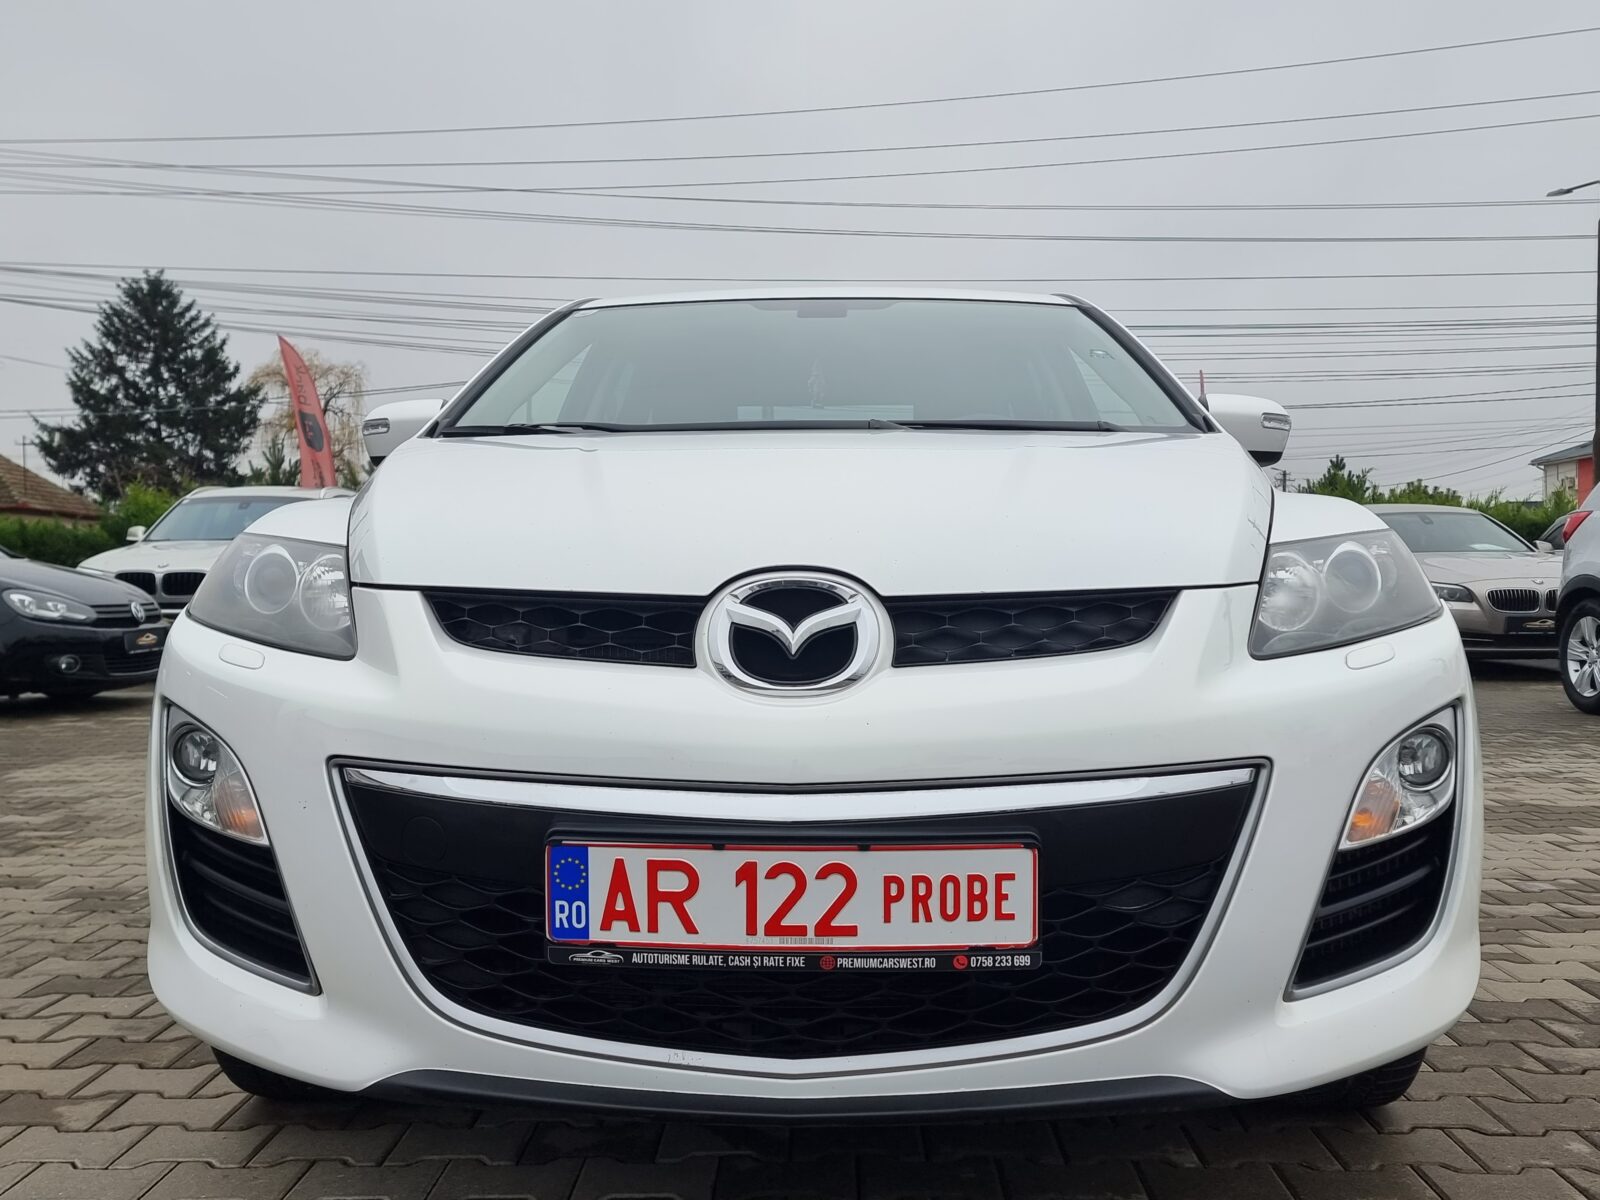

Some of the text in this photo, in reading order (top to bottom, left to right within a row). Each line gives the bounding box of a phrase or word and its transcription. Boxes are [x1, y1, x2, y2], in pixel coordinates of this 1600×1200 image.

[600, 858, 1016, 937] AR 122 PROBE
[555, 900, 586, 928] RO
[631, 952, 690, 965] AUTOTURISME
[692, 955, 727, 967] RULATE,
[728, 955, 751, 967] CASH
[763, 956, 784, 967] RATE
[786, 956, 806, 967] FIXE
[837, 957, 936, 968] PREMIUMCARSWEST.RO
[970, 955, 1031, 967] 0758 233 699
